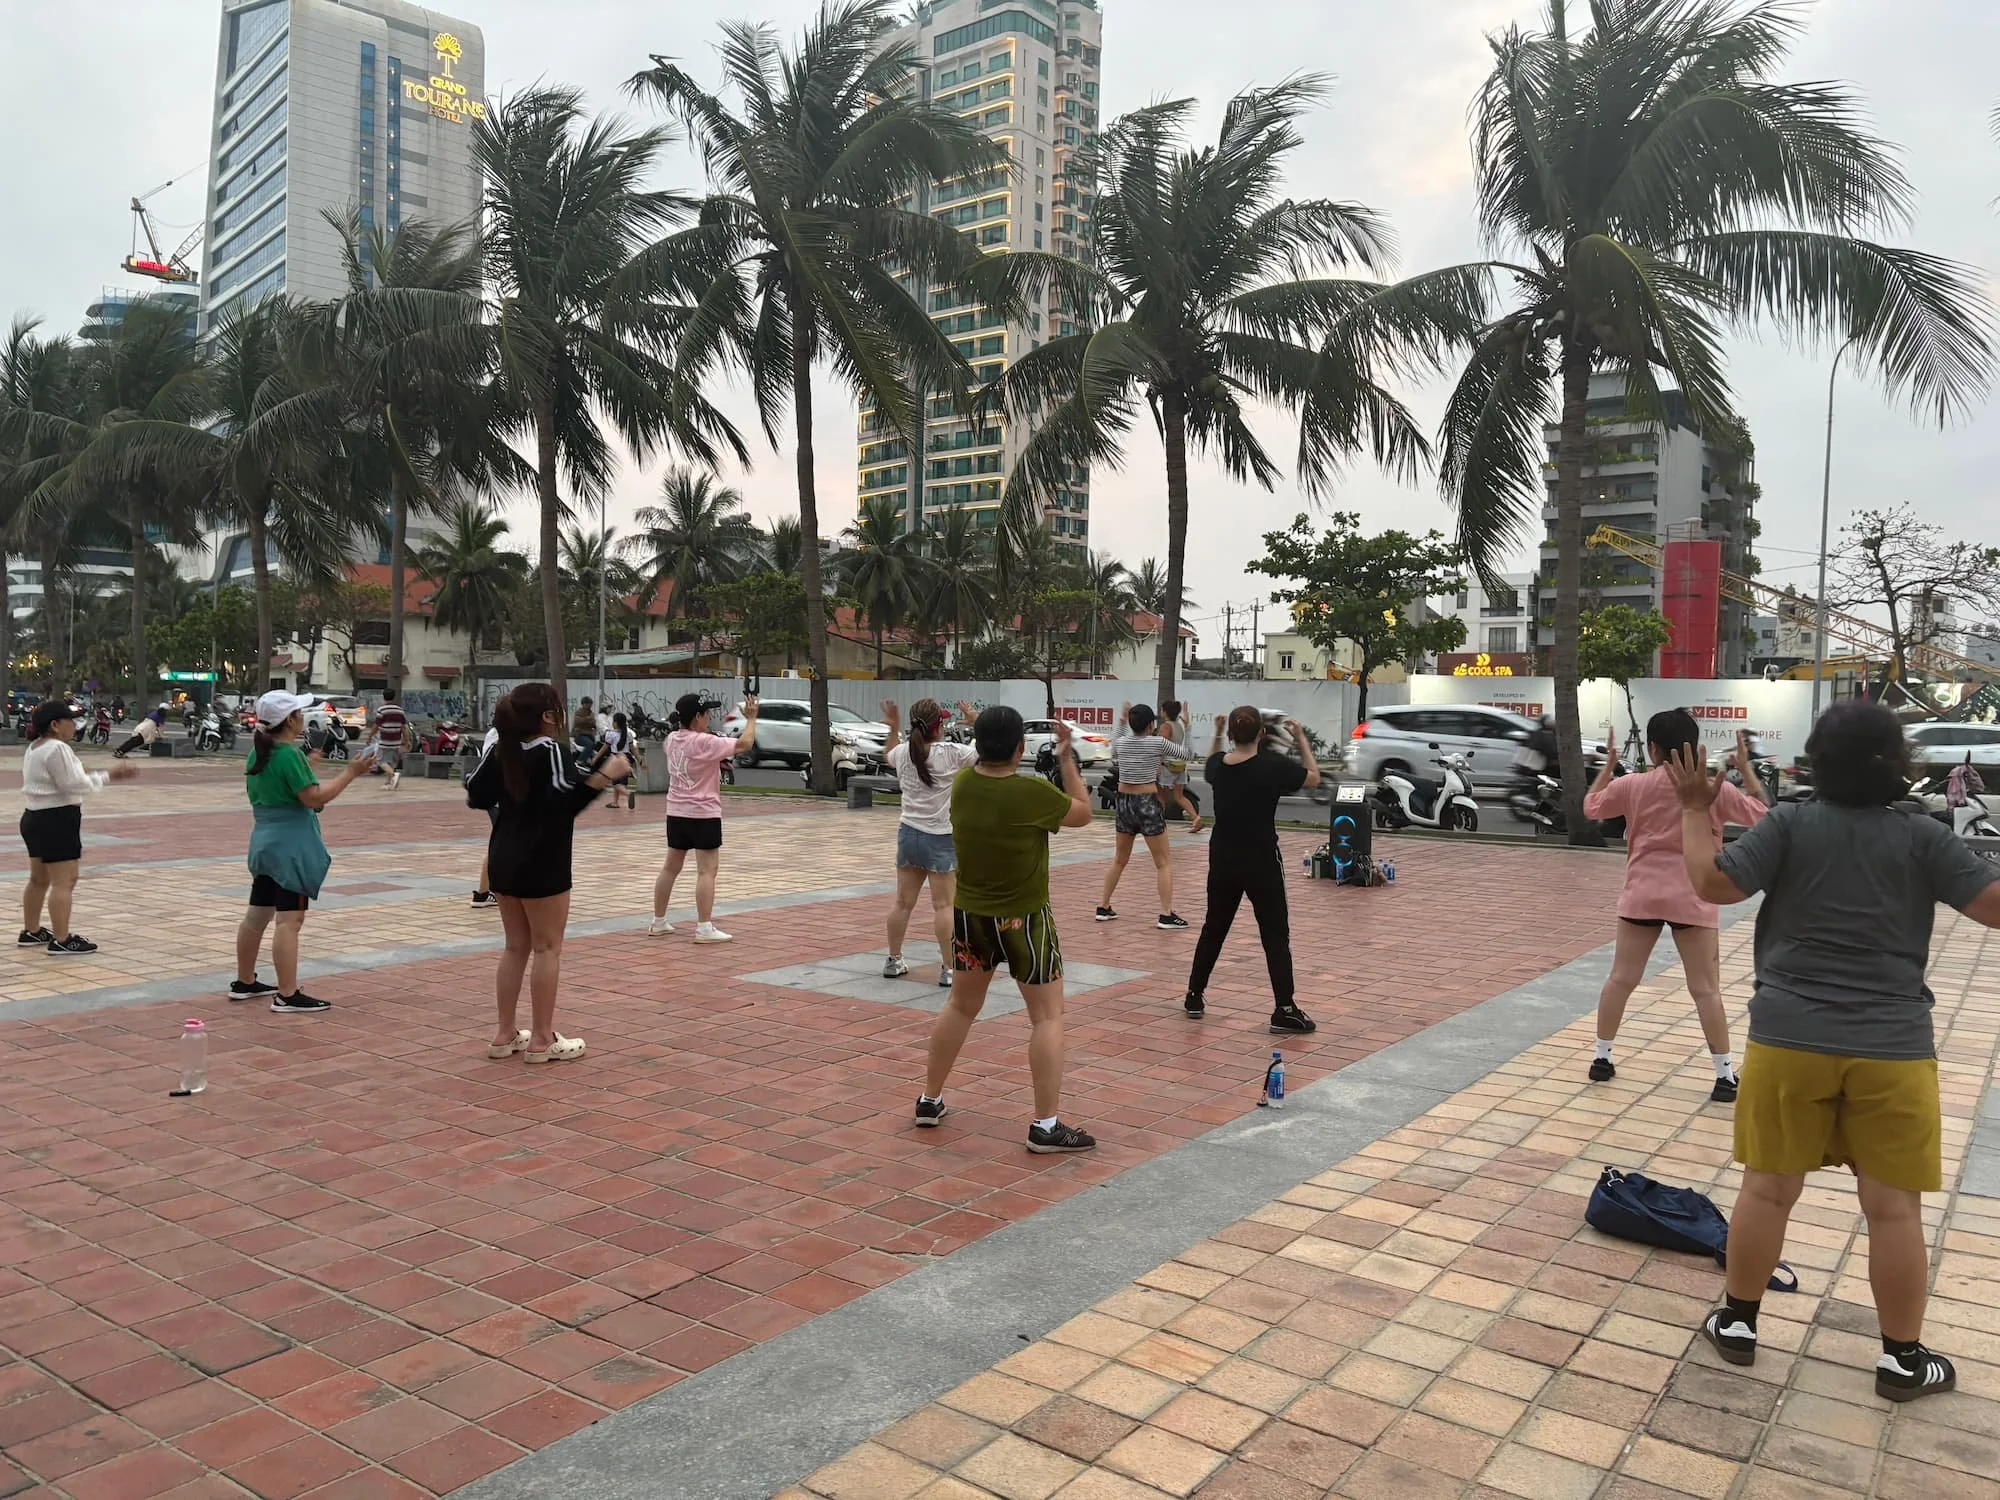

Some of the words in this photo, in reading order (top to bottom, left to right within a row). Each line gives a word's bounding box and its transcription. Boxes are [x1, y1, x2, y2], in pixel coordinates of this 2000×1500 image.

[429, 76, 467, 95] GRAND
[1468, 666, 1493, 677] COOL
[1494, 666, 1513, 677] SPA
[1694, 708, 1745, 717] VCRE
[1704, 729, 1733, 739] THAT
